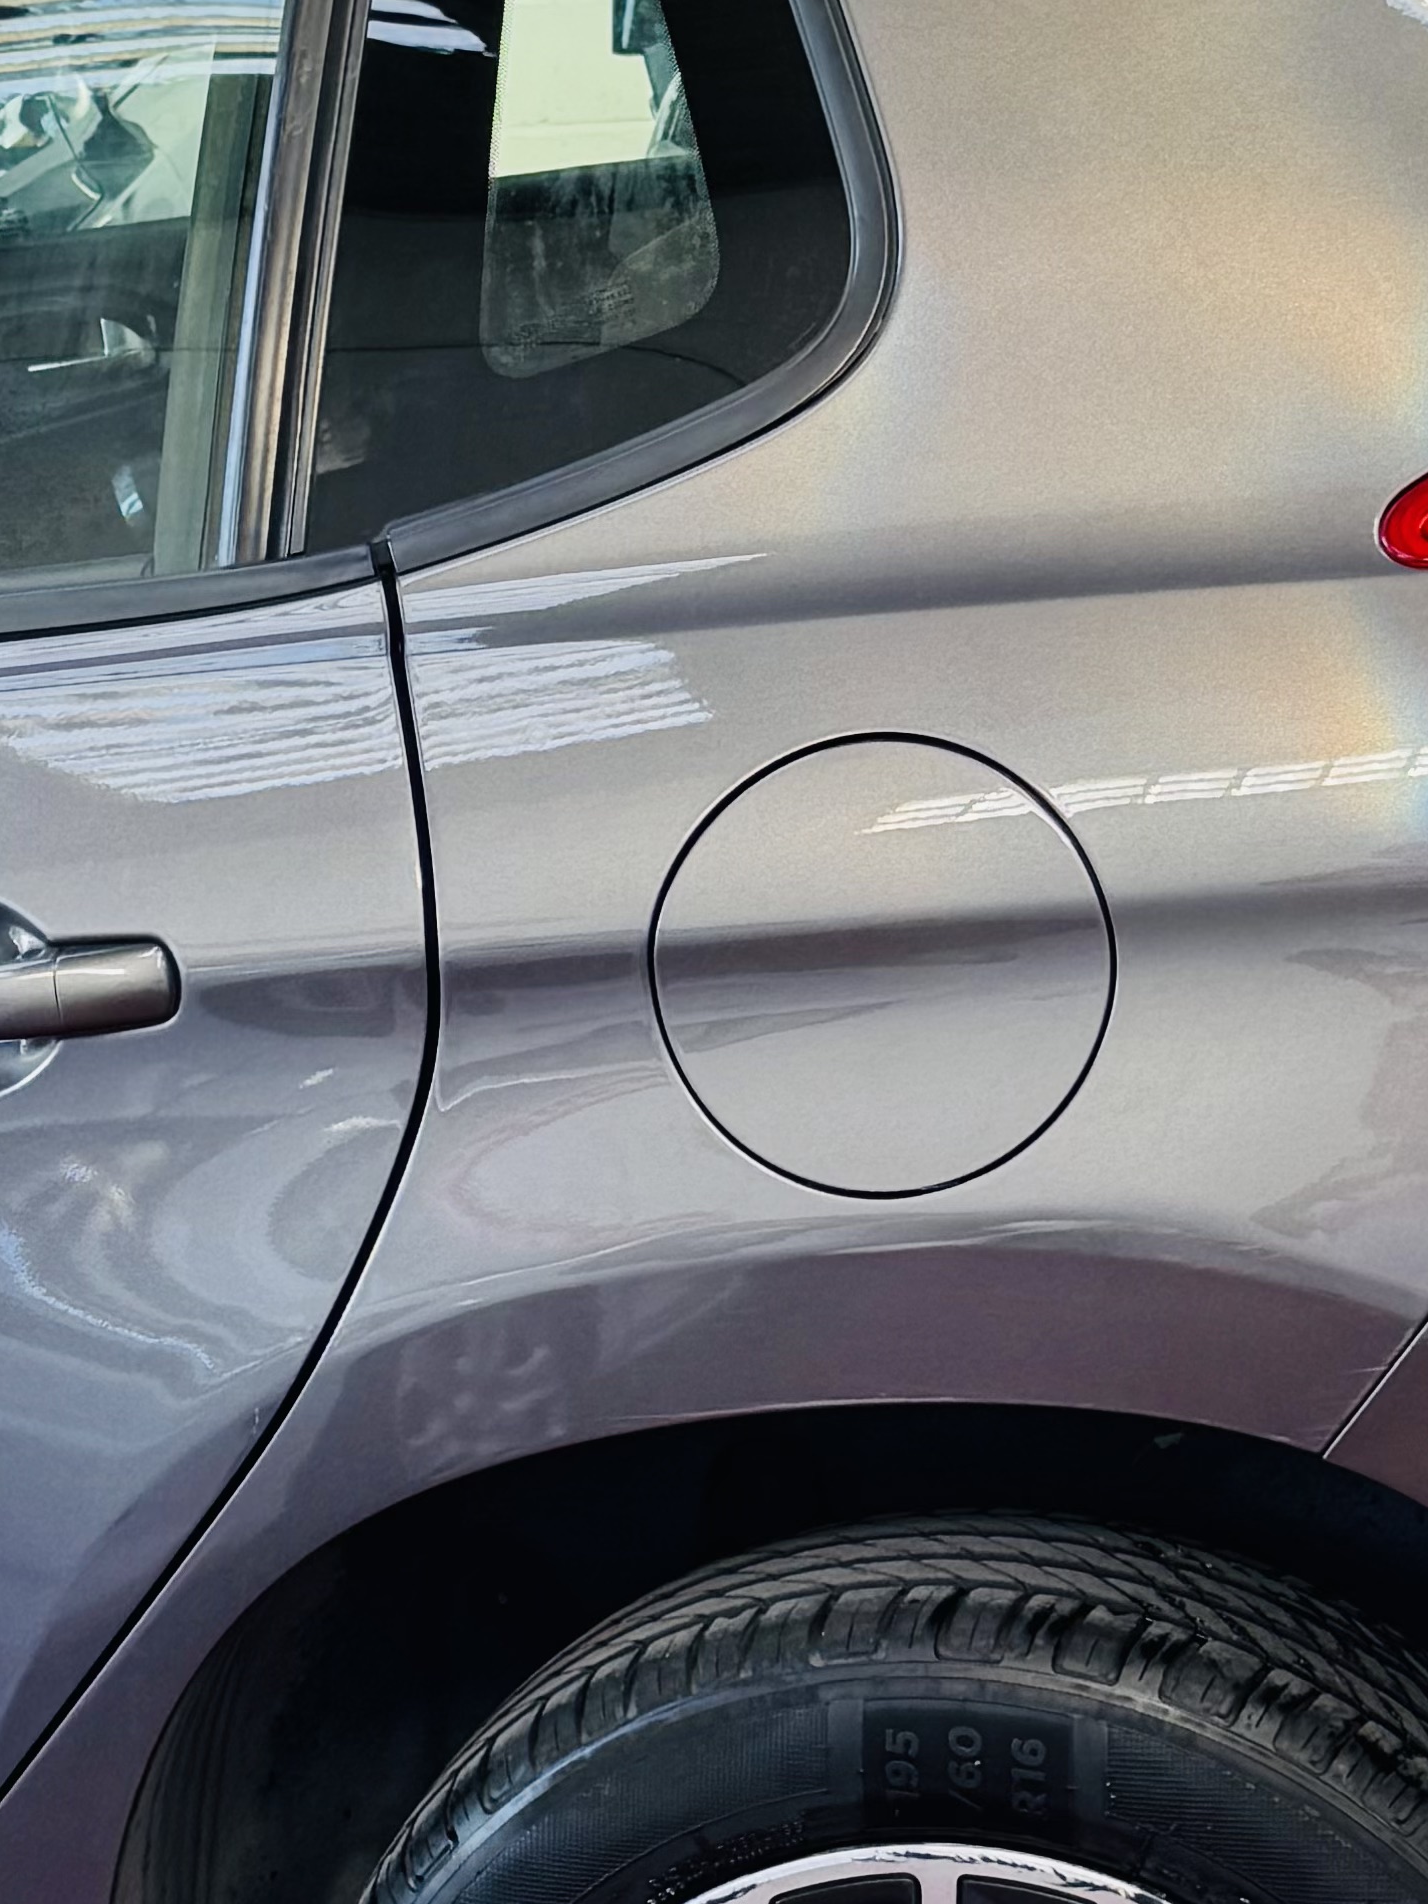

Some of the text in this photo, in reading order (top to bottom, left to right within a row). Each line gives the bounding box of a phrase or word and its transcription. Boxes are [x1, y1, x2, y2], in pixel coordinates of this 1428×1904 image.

[885, 1728, 920, 1799] 195
[947, 1726, 983, 1812] /60
[1010, 1737, 1047, 1817] R16
